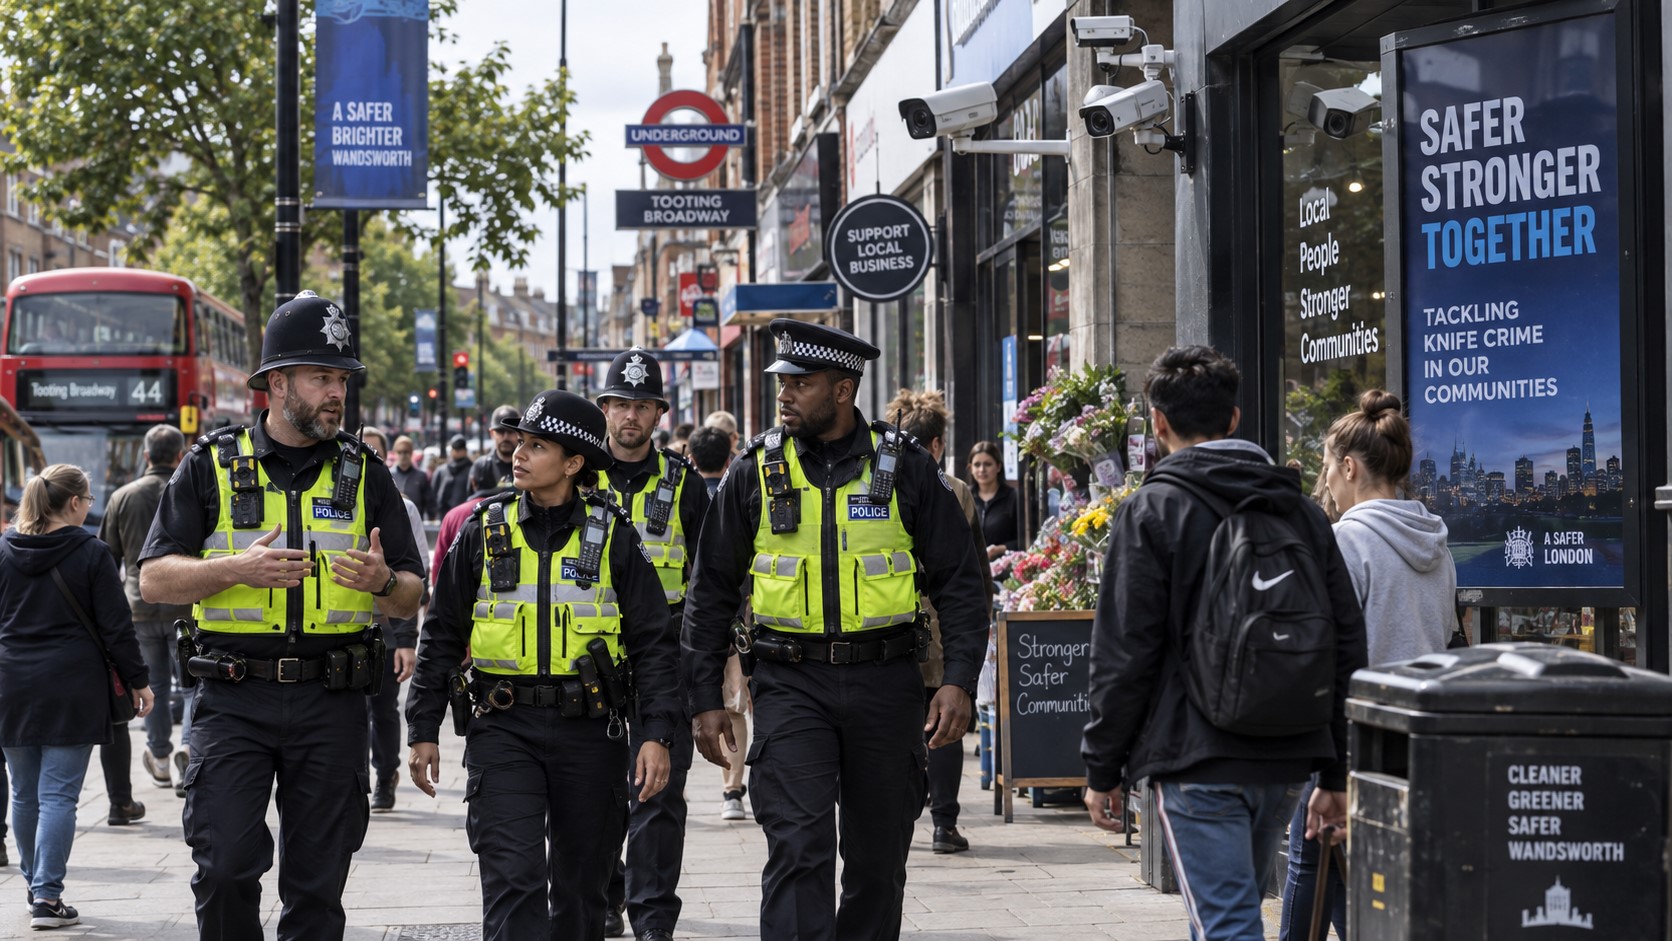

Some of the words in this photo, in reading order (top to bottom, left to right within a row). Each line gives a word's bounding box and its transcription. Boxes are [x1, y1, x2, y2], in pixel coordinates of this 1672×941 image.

[332, 101, 343, 121] A
[347, 101, 393, 122] SAFER
[332, 126, 402, 146] BRIGHTER
[631, 129, 740, 142] UNDERGROUND
[1420, 96, 1525, 156] SAFER
[332, 149, 412, 166] WANDSWORTH
[1421, 144, 1601, 213] STRONGER
[651, 195, 722, 208] TOOTING
[1299, 186, 1330, 228] Local
[643, 209, 730, 223] BROADWAY
[847, 224, 910, 243] SUPPORT
[1421, 205, 1597, 270] TOGETHER
[857, 241, 903, 257] LOCAL
[1300, 232, 1339, 276] People
[849, 255, 914, 274] BUSINESS
[1300, 284, 1351, 321] Stronger
[1423, 300, 1519, 326] TACKLING
[1300, 321, 1379, 364] Communities
[1424, 330, 1478, 352] KNIFE
[1483, 325, 1544, 348] CRIME
[1424, 359, 1443, 378] IN
[1448, 356, 1490, 377] OUR
[31, 382, 68, 400] Tooting
[69, 382, 116, 400] Broadway
[131, 380, 162, 403] 44
[1424, 377, 1558, 404] COMMUNITIES
[315, 507, 351, 519] POLICE
[851, 506, 888, 517] POLICE
[1544, 531, 1551, 545] A
[1553, 531, 1584, 545] SAFER
[1544, 548, 1593, 565] LONDON
[1017, 633, 1089, 667] Stronger
[1019, 663, 1069, 690] Safer
[1508, 765, 1582, 785] CLEANER
[1508, 790, 1584, 811] GREENER
[1508, 815, 1561, 835] SAFER
[1508, 841, 1624, 862] WANDSWORTH
